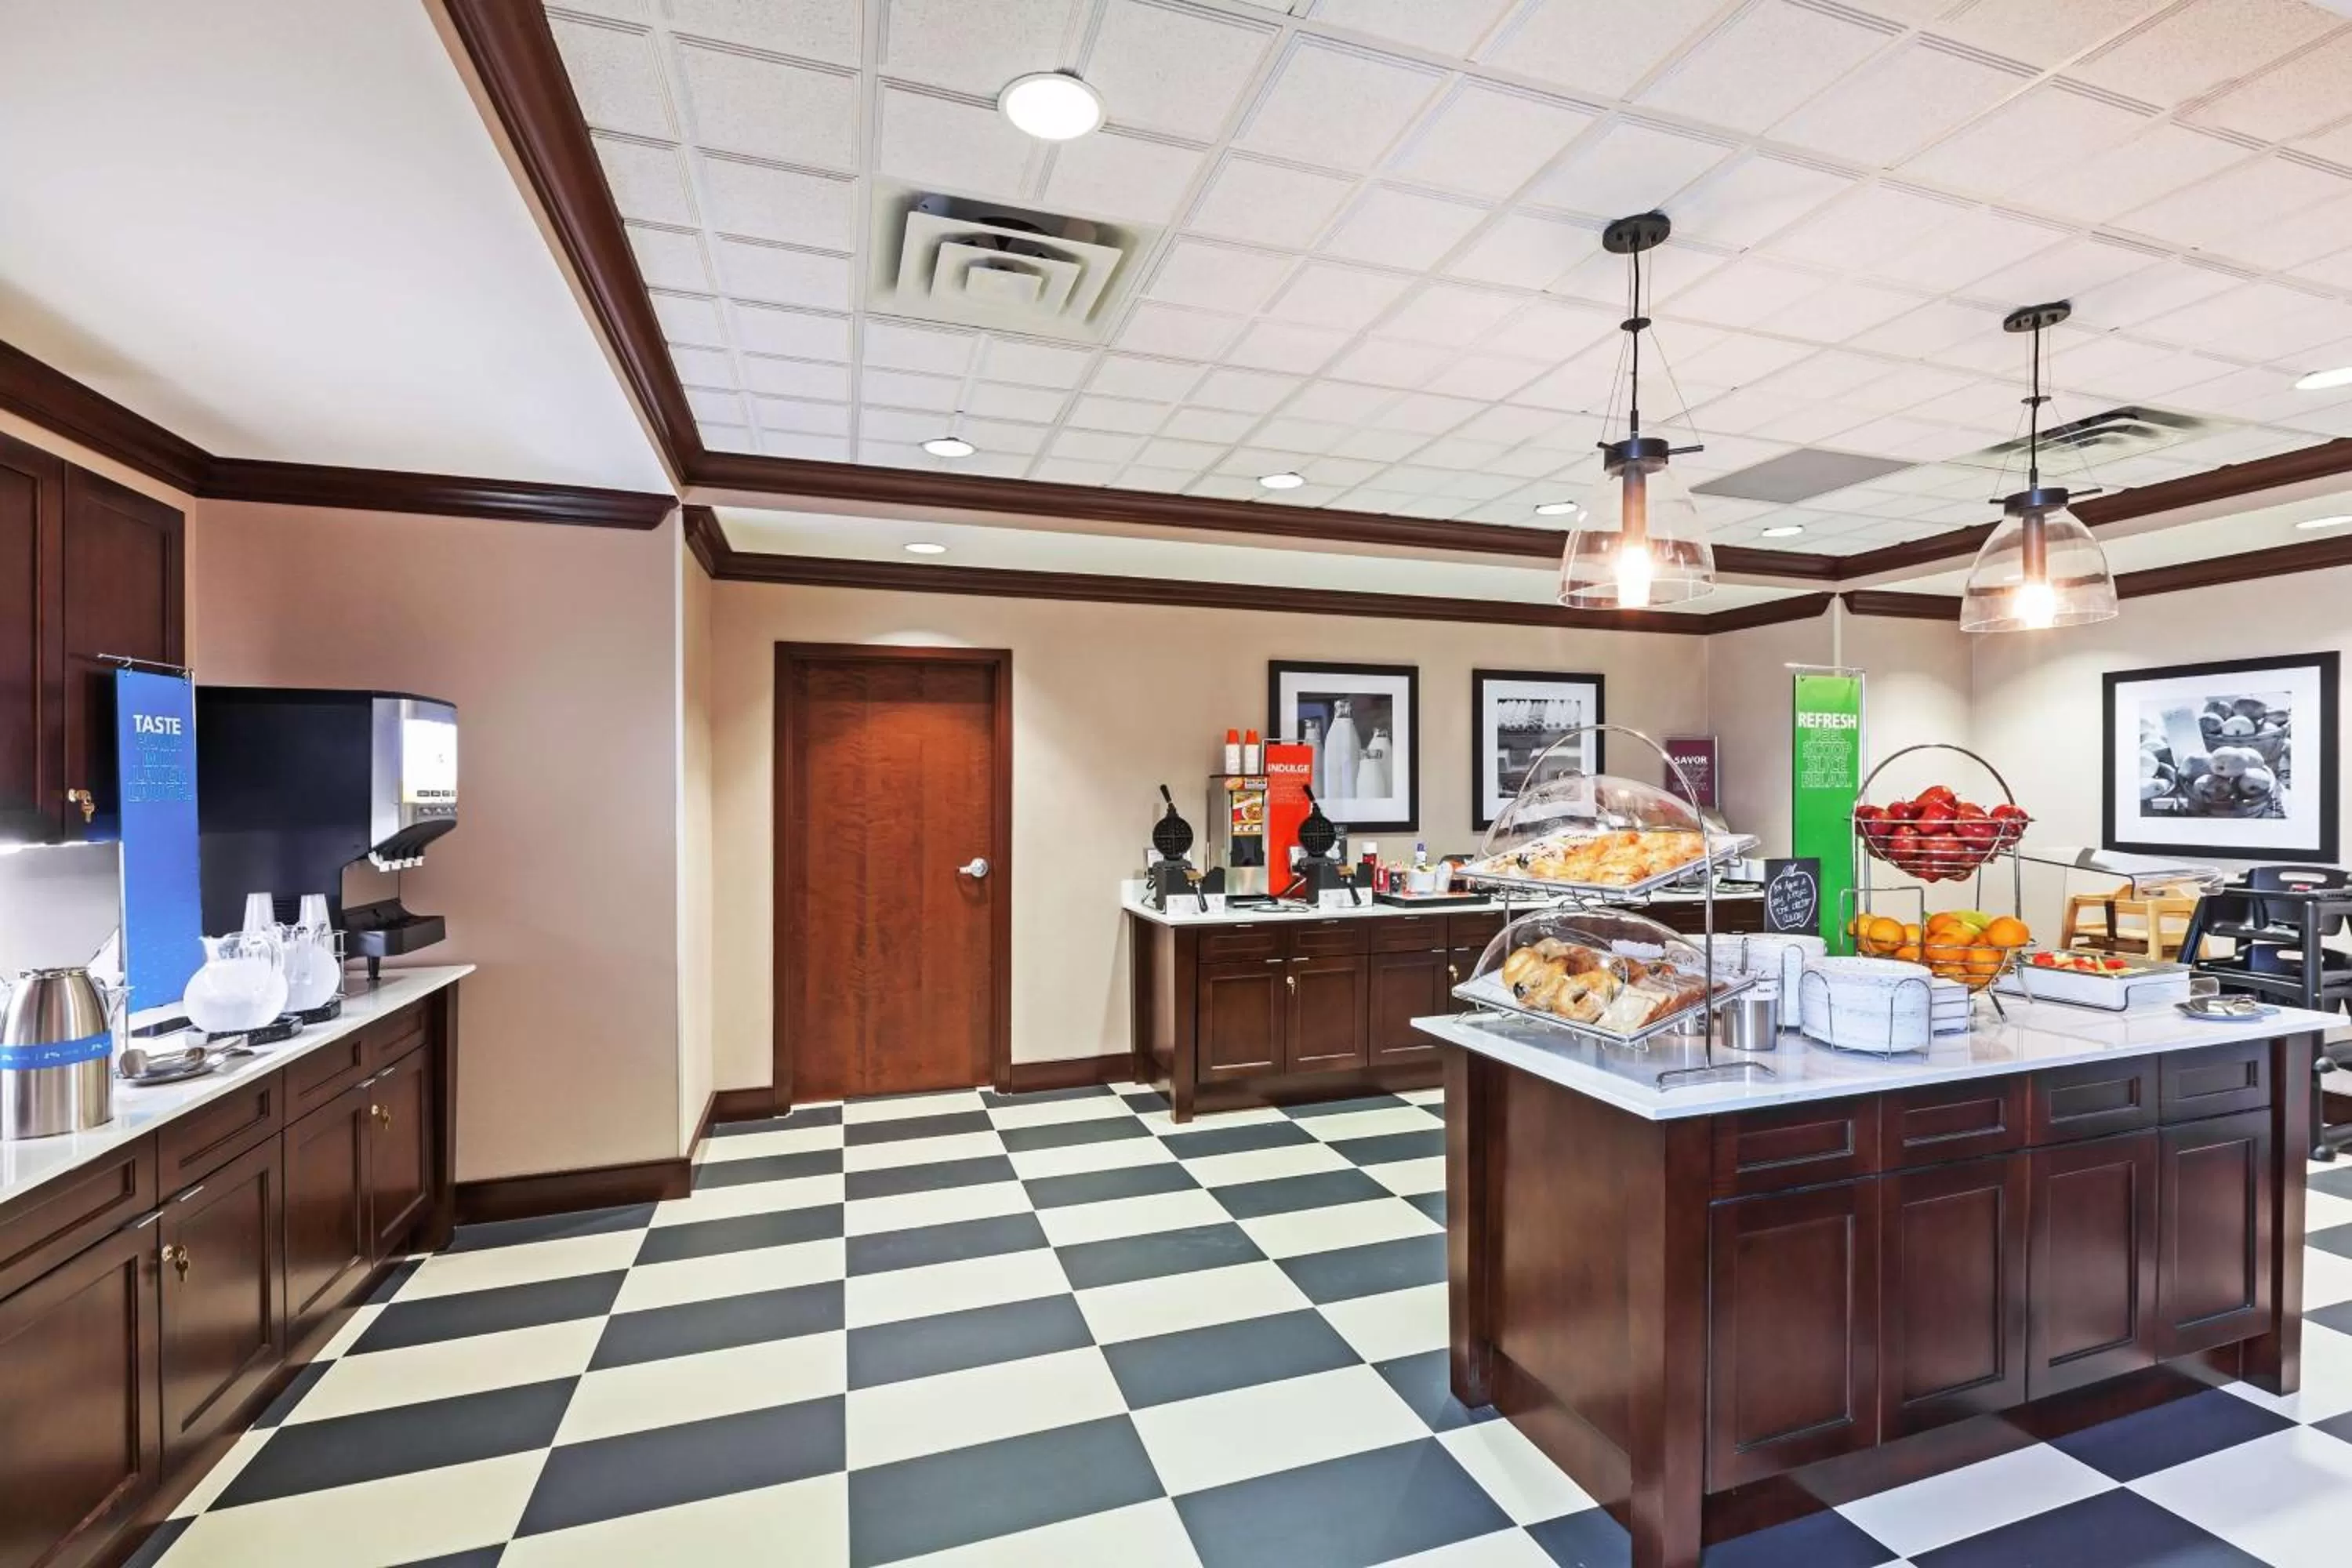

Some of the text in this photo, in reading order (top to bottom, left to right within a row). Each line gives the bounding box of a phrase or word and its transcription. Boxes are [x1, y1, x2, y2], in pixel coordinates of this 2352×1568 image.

[132, 714, 182, 735] TASTE
[1798, 711, 1857, 729] REFRESH
[1674, 755, 1708, 764] SAVOR
[1267, 763, 1310, 773] INDULGE
